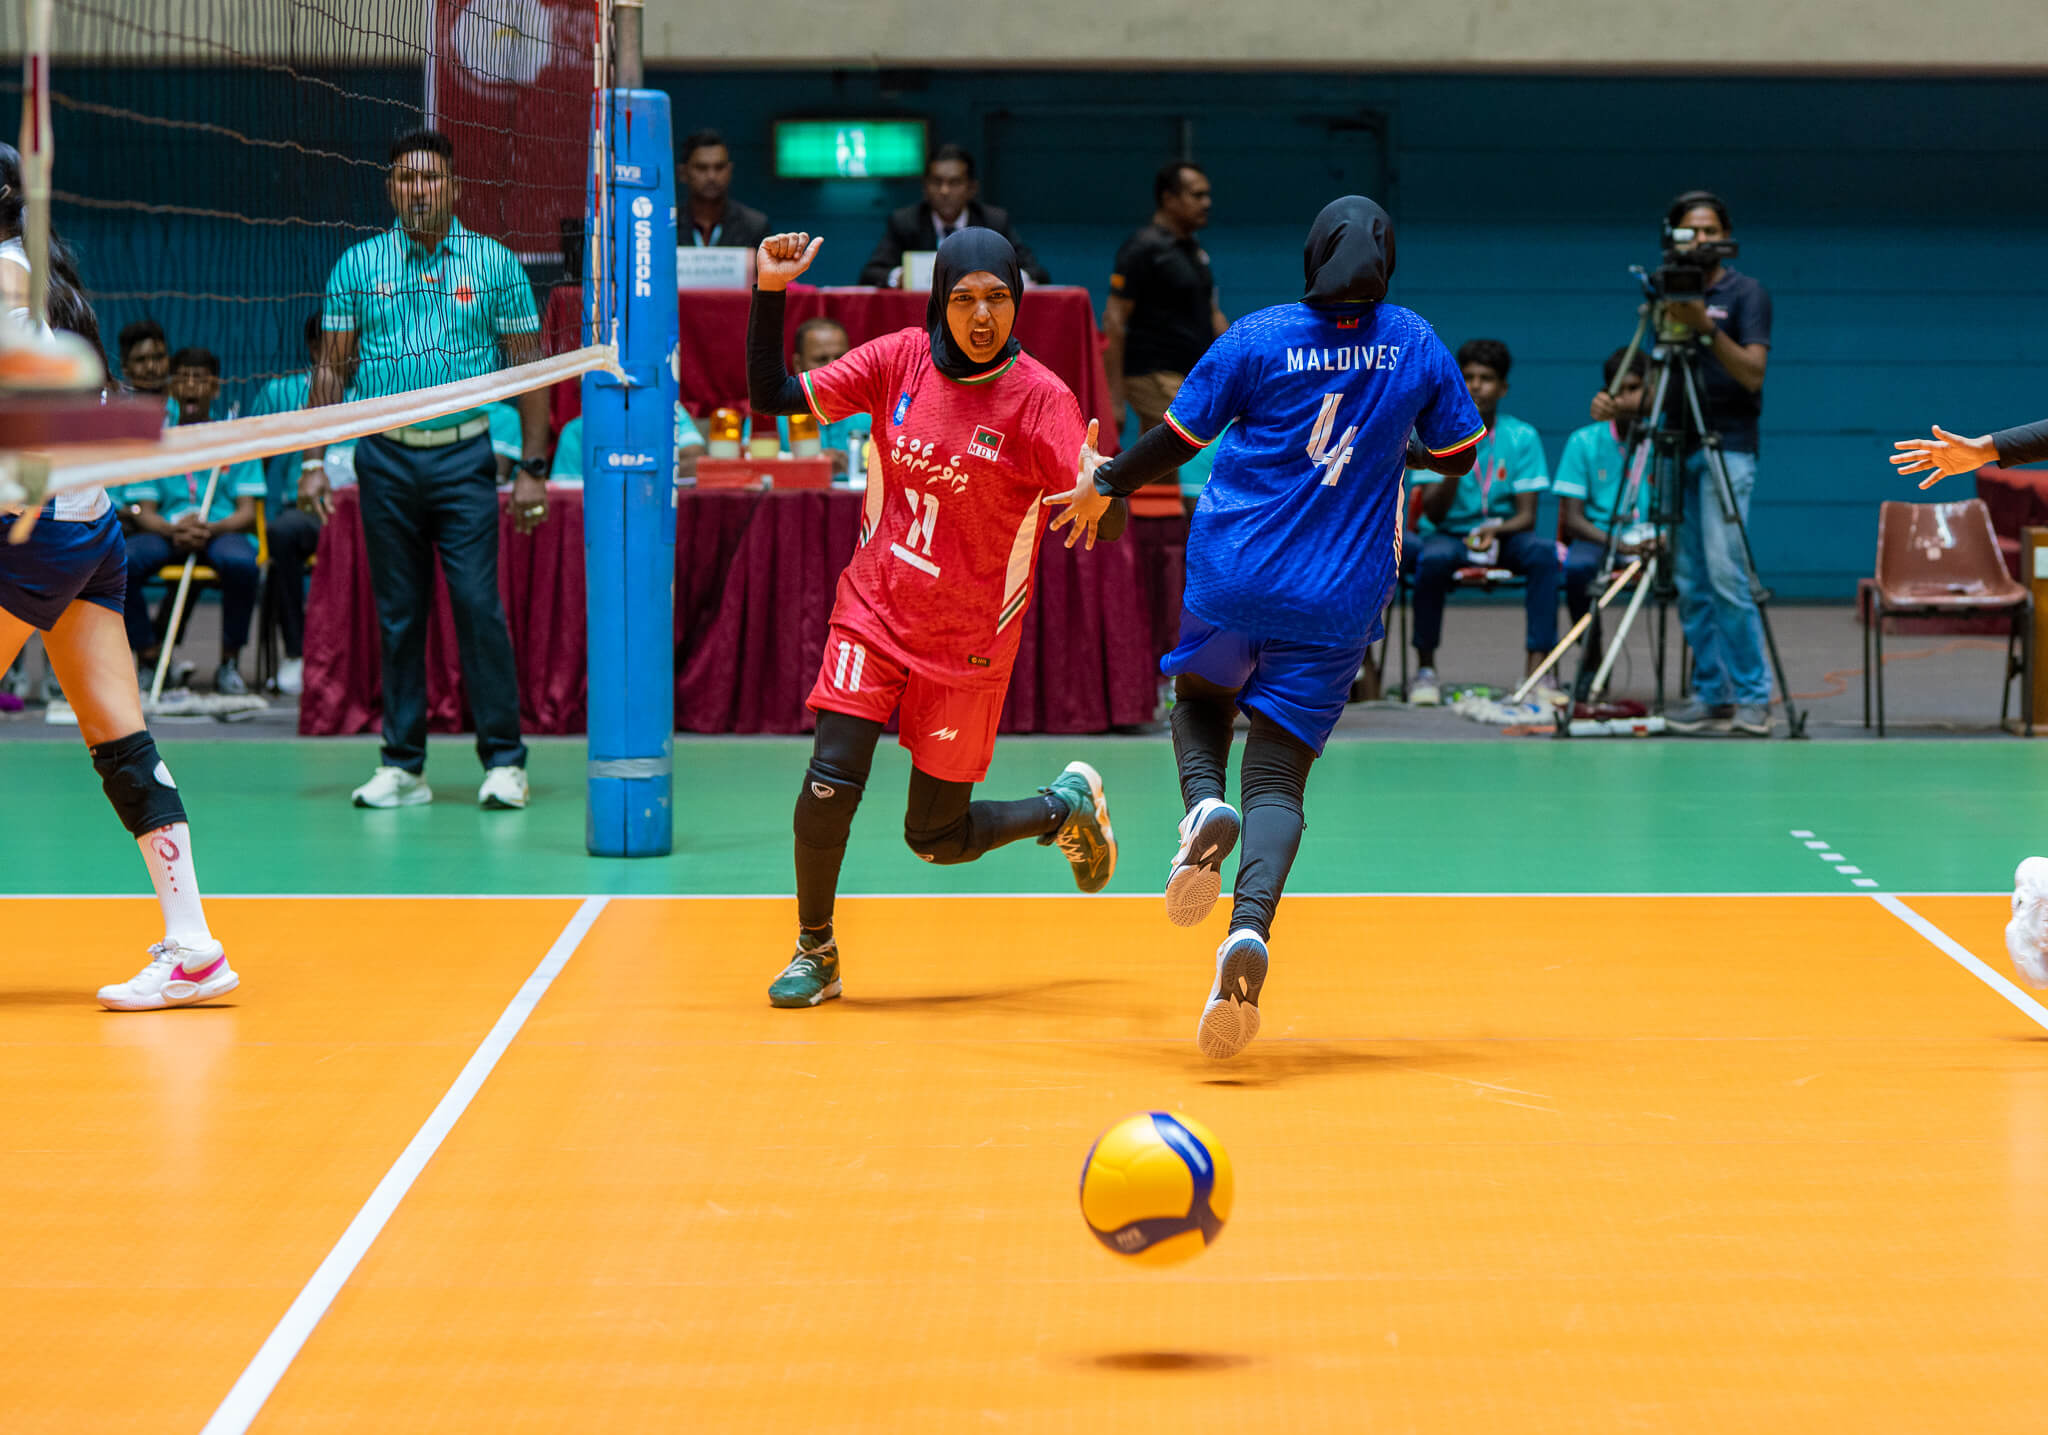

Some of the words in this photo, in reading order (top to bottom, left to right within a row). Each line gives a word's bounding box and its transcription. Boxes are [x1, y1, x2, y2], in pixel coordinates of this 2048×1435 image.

[635, 220, 652, 297] Senoh
[1287, 345, 1400, 372] MALDIVES
[969, 444, 998, 460] MDV
[1306, 393, 1359, 487] 4
[833, 640, 866, 692] 11
